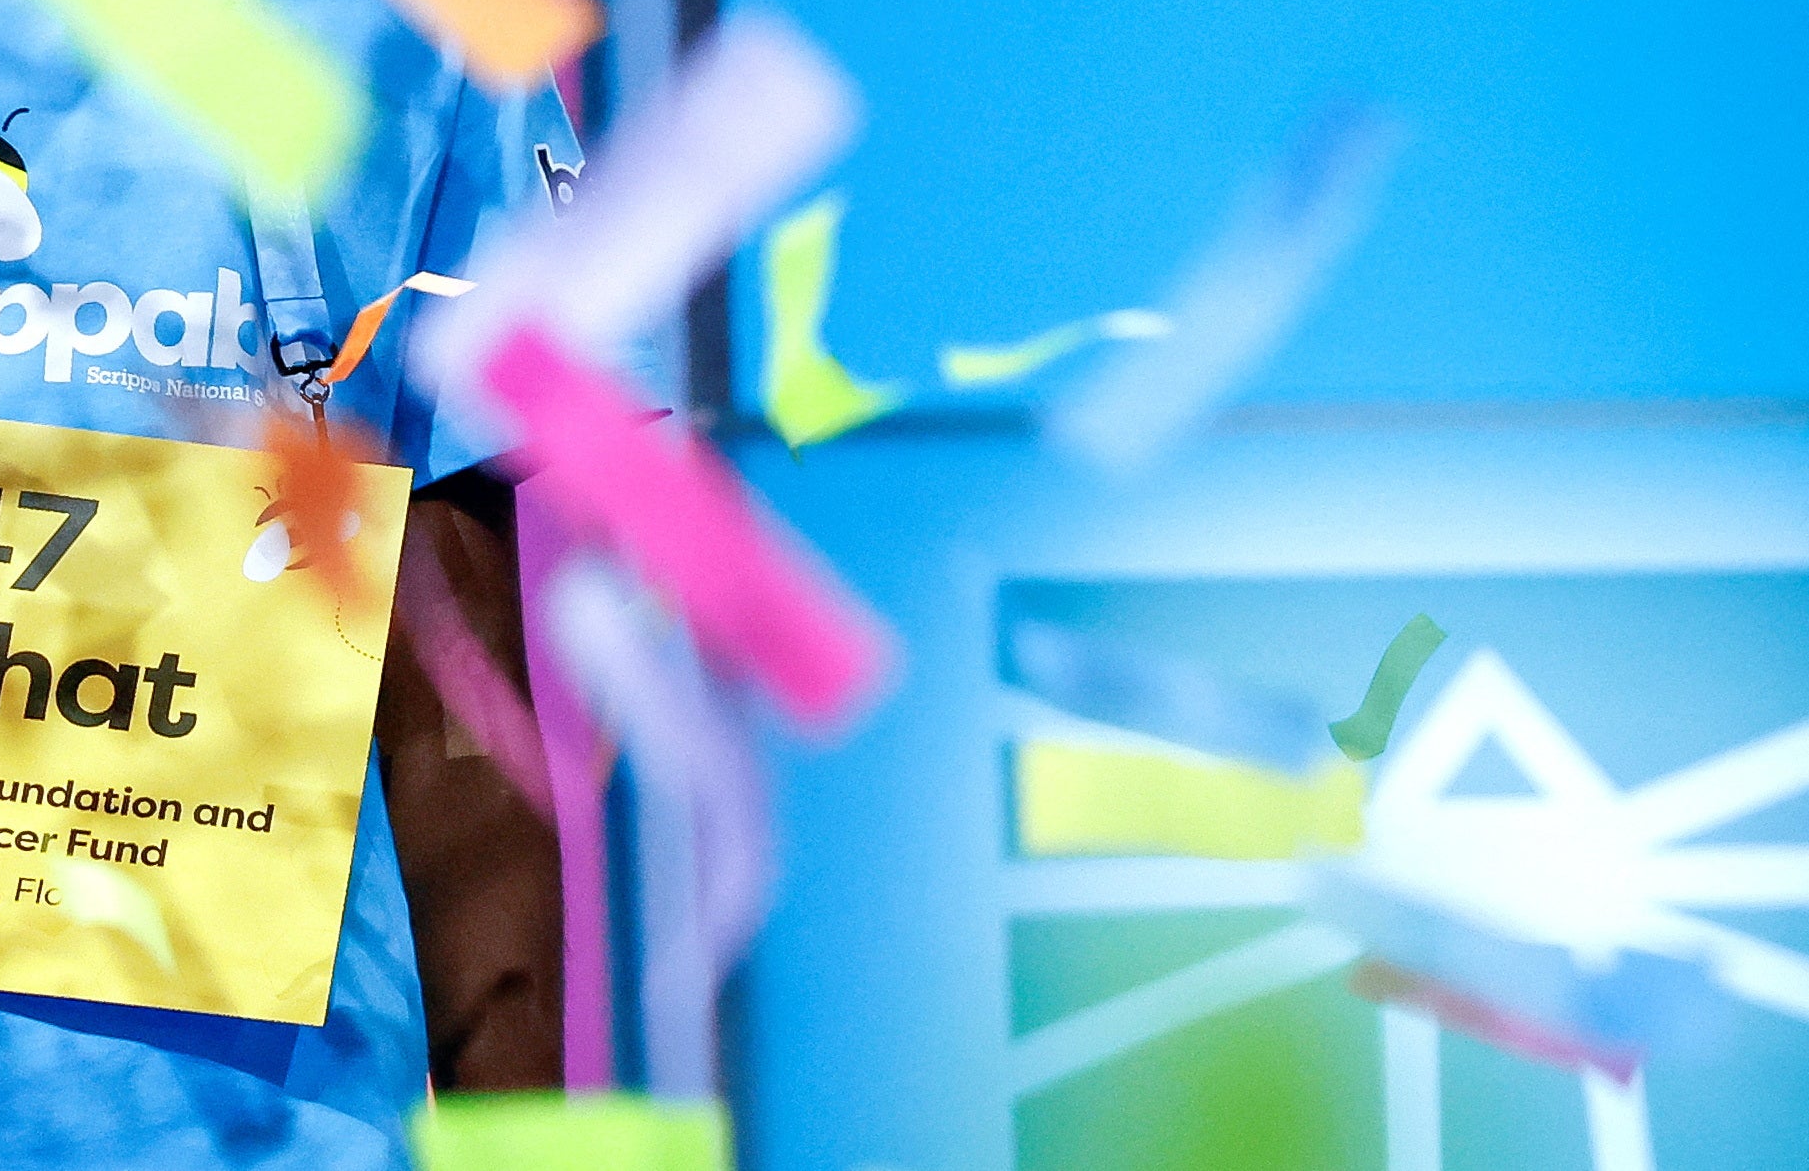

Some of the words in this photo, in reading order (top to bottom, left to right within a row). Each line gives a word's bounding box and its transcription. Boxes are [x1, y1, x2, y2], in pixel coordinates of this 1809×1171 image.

[86, 365, 161, 393] Scripps
[165, 379, 251, 403] National
[193, 803, 275, 833] and
[66, 828, 169, 868] Fund
